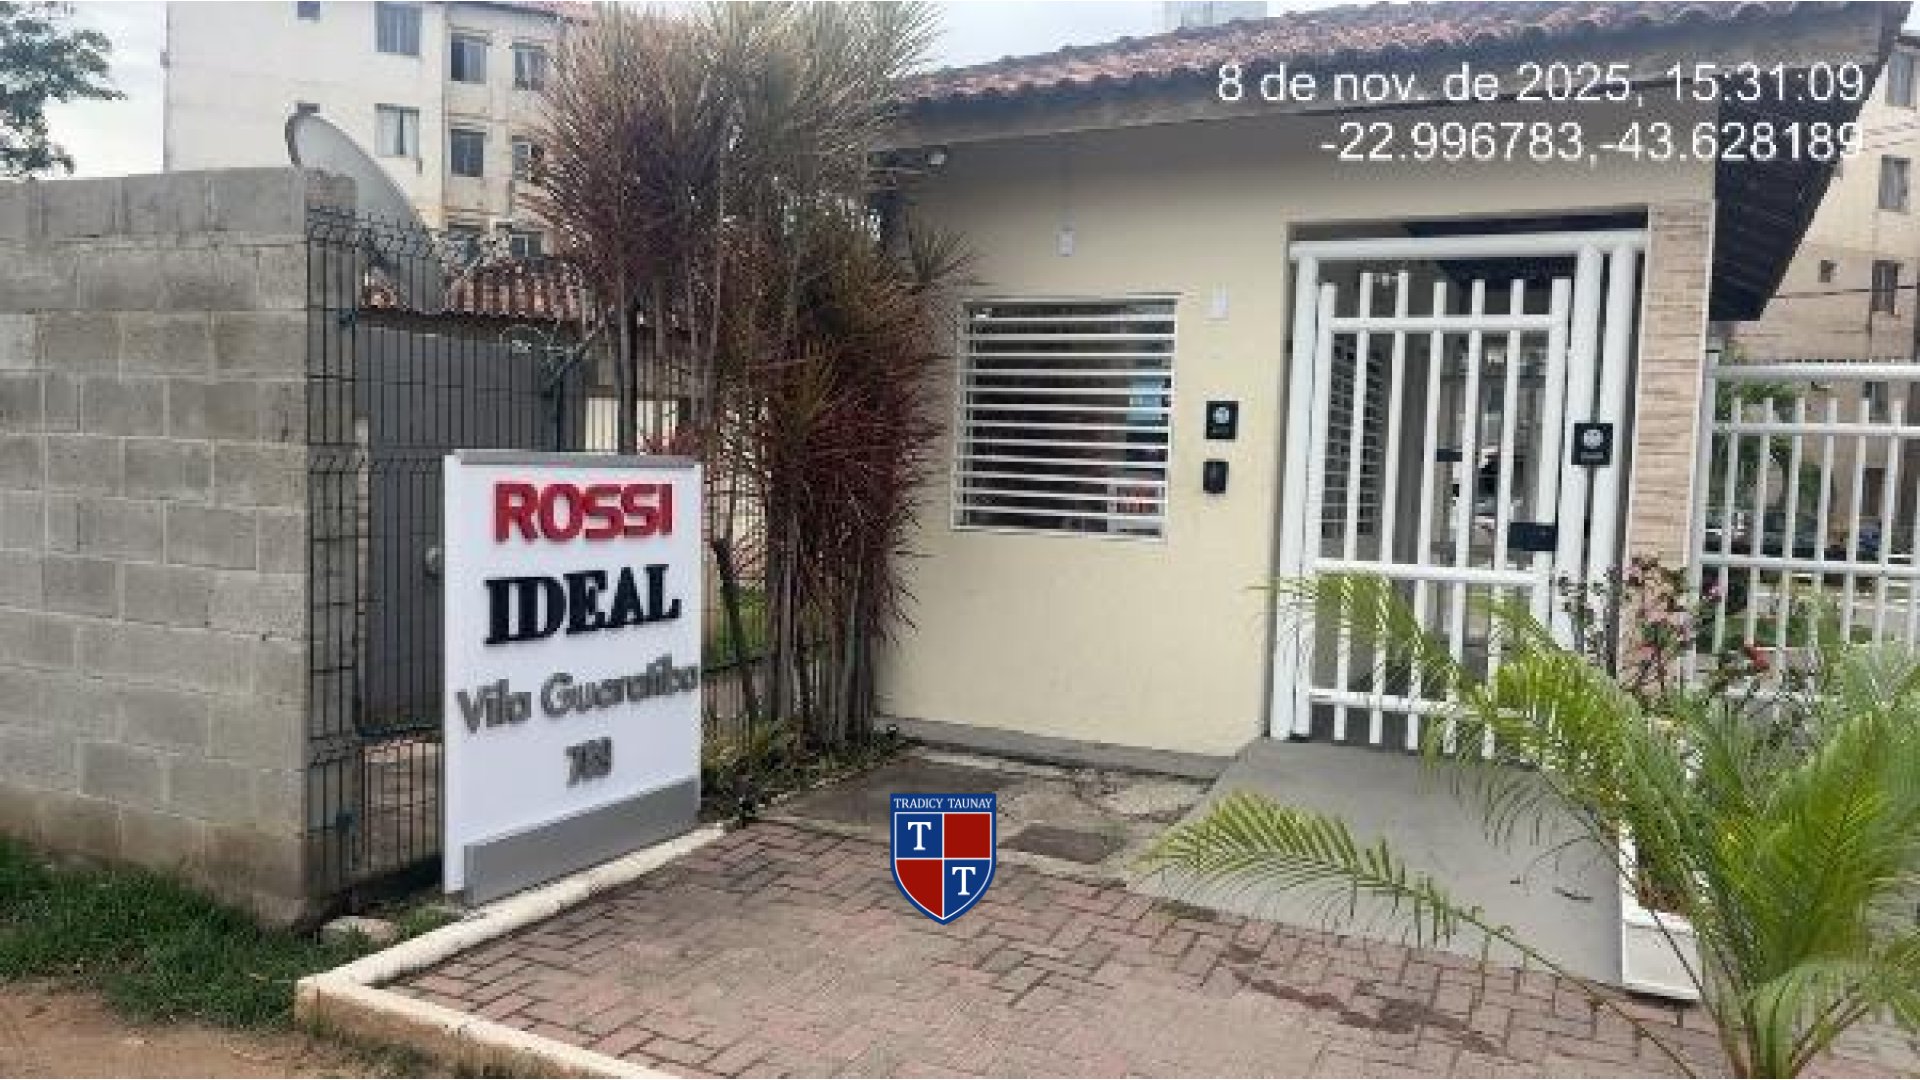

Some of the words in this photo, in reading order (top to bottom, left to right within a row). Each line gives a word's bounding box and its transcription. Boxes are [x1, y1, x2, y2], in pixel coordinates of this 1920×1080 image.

[494, 481, 674, 545] ROSSI
[483, 563, 683, 648] IDEAL
[457, 678, 533, 734] Vila
